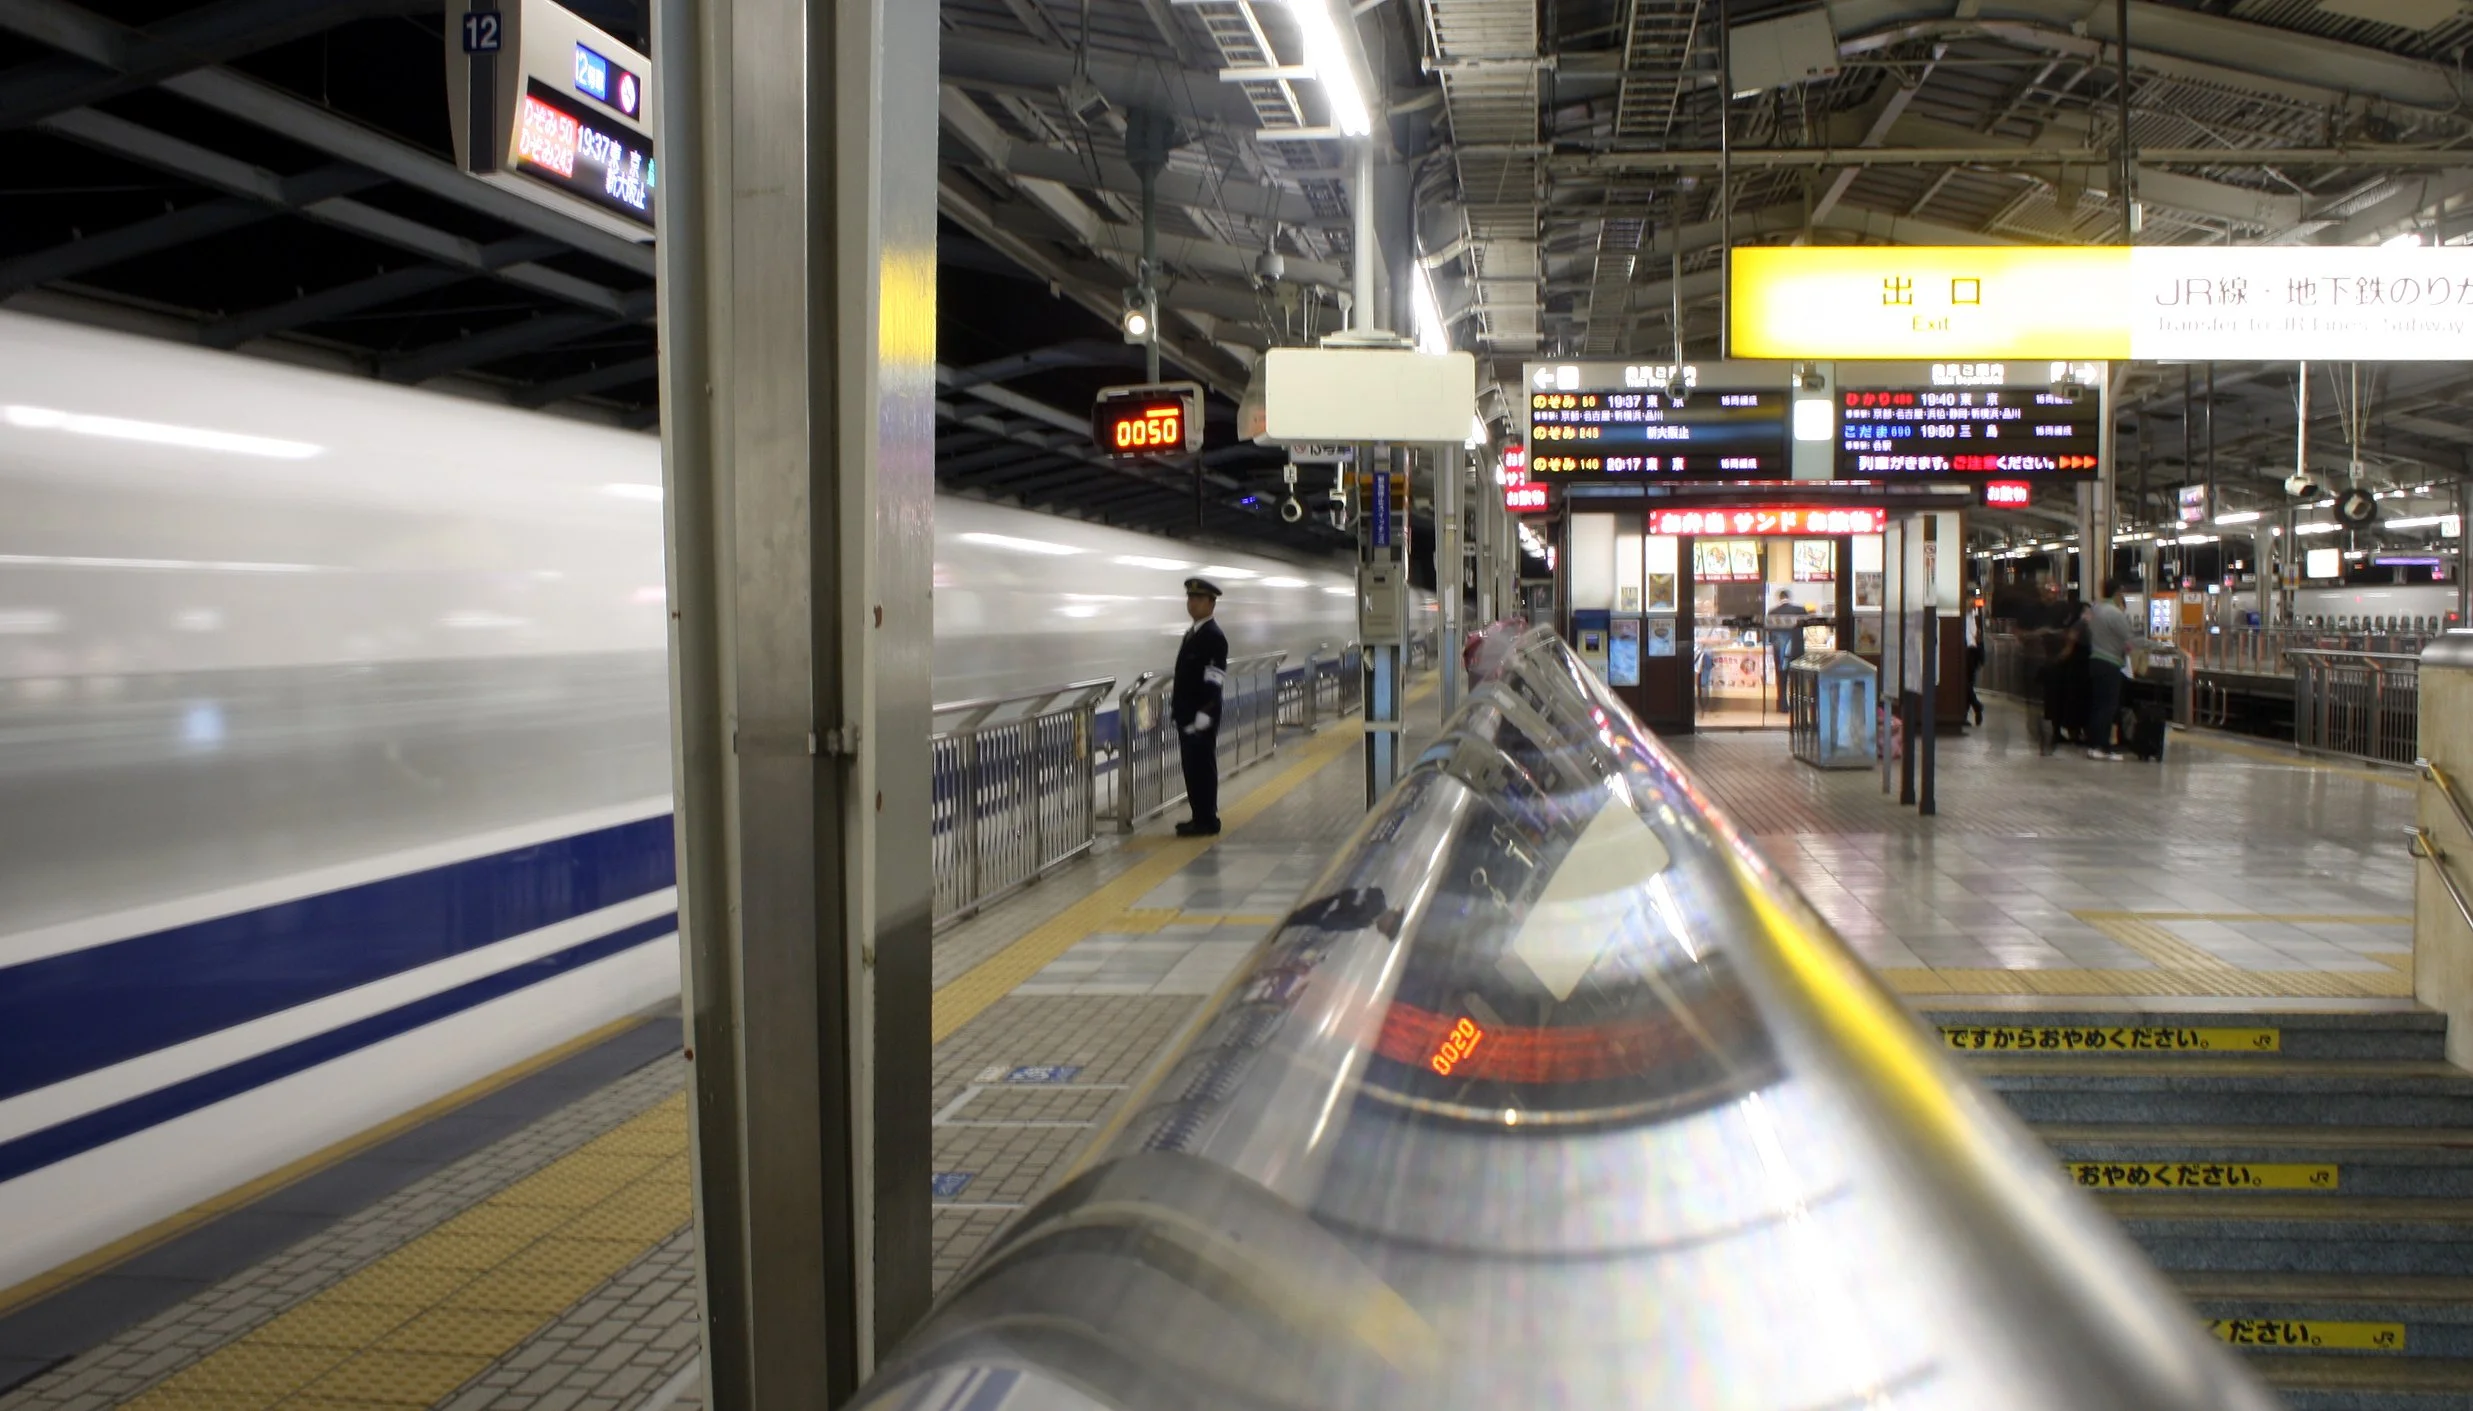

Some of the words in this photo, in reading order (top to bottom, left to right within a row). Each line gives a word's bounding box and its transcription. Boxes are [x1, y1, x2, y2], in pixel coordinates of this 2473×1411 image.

[466, 17, 497, 49] 12
[577, 126, 609, 163] 19:37
[1913, 315, 1949, 331] Exit
[1533, 395, 1575, 409] のぞみ
[1608, 395, 1641, 408] 19:37
[1921, 393, 1955, 406] 19:40
[1117, 418, 1177, 447] 0050
[1533, 426, 1575, 440] のぞみ
[1646, 426, 1690, 440] 新大阪止
[1533, 457, 1575, 471] のぞみ
[1733, 512, 1797, 533] サンド
[2252, 1034, 2272, 1048] JR
[2309, 1170, 2330, 1185] JR
[2373, 1331, 2395, 1345] JR
